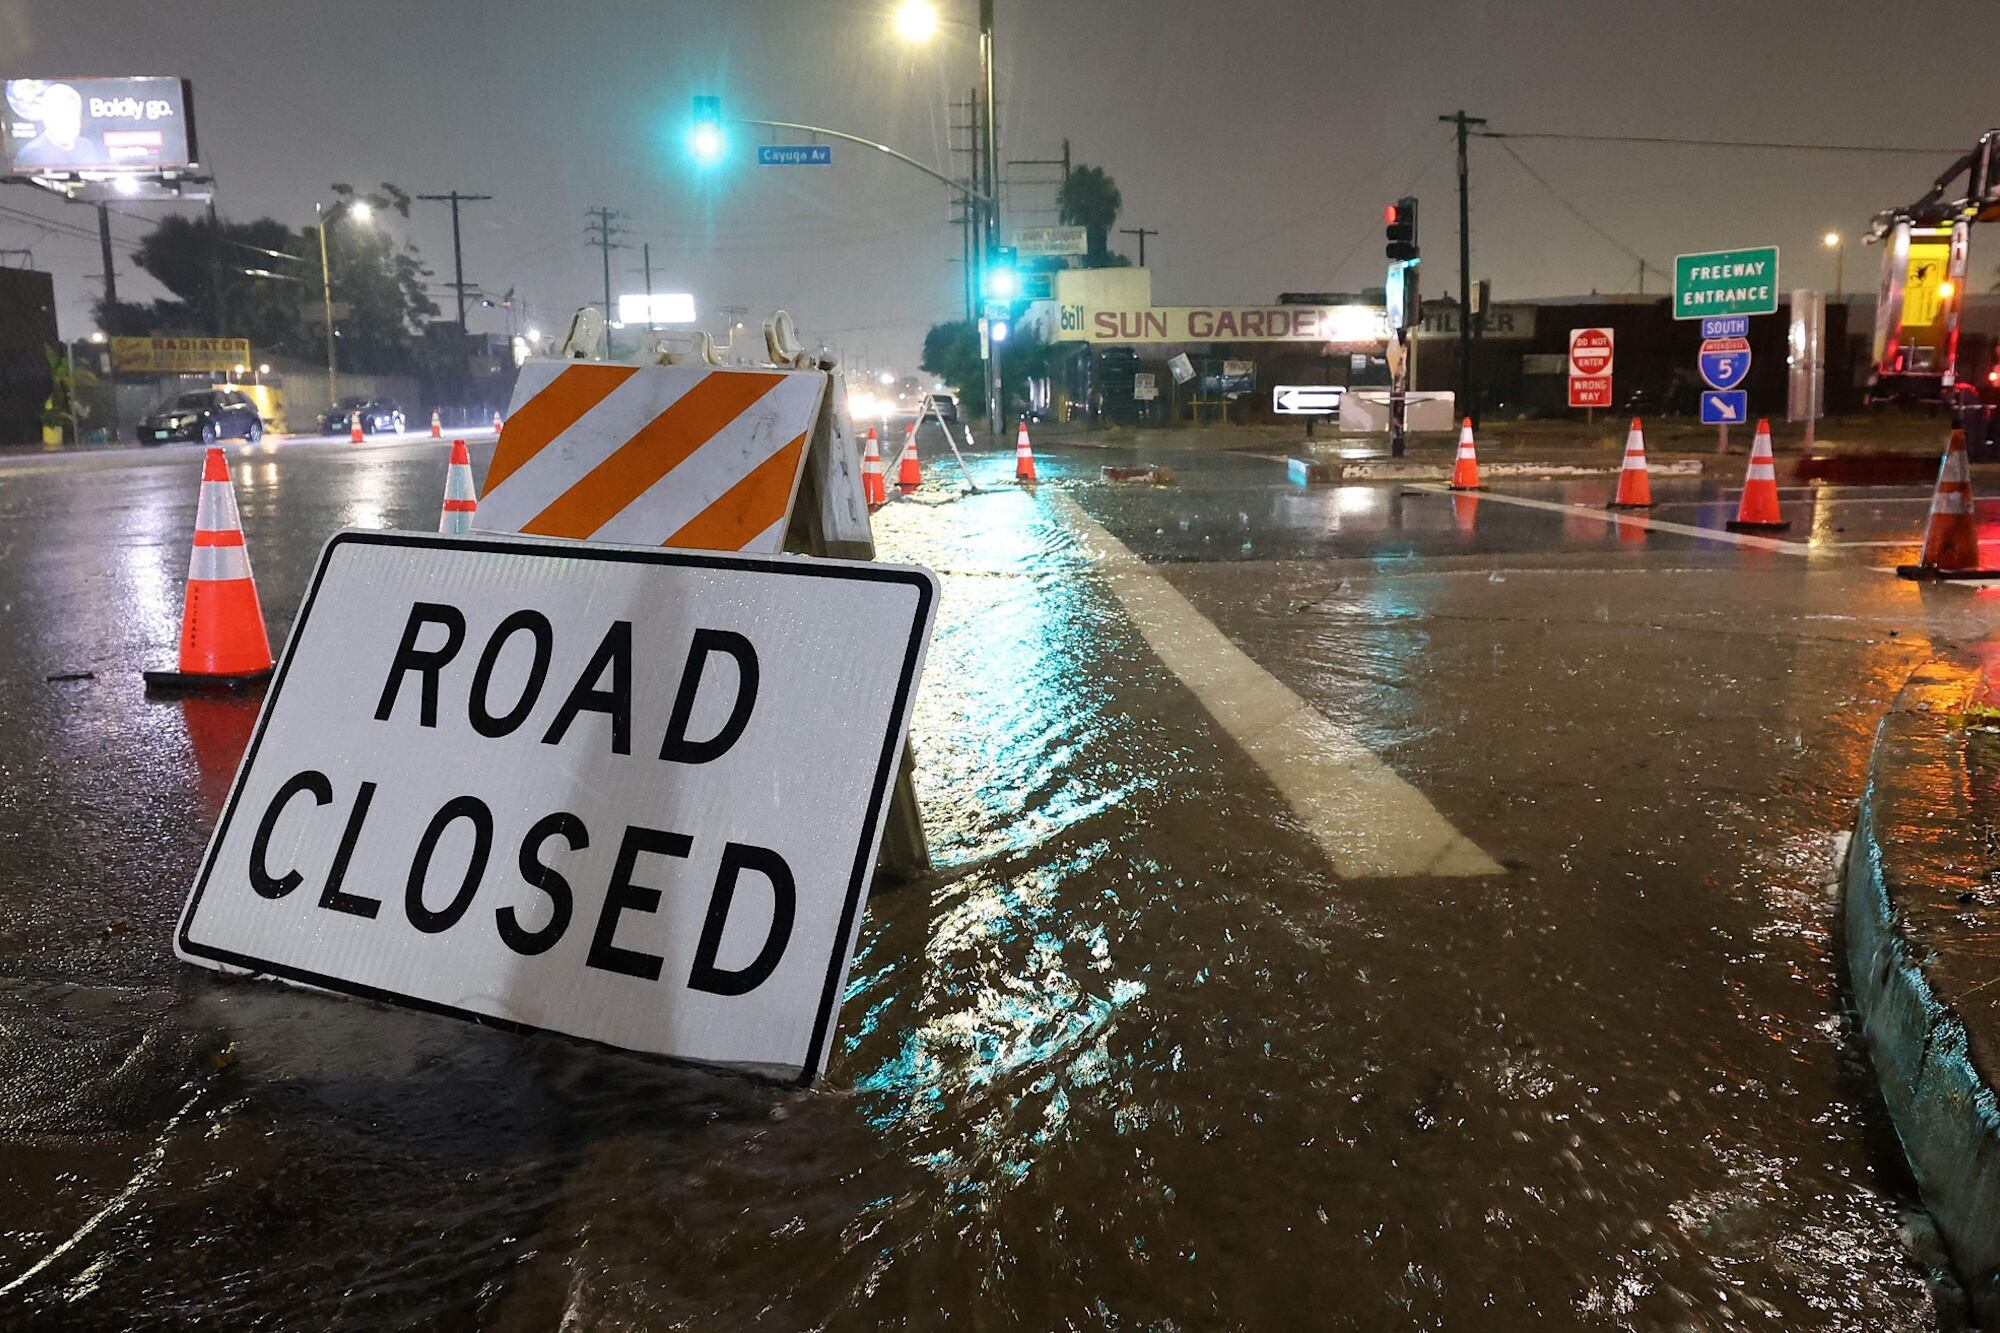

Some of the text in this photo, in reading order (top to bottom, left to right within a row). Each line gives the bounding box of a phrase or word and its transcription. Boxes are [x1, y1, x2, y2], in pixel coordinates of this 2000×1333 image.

[89, 98, 173, 121] Boldly go.
[764, 150, 825, 162] Cayuga Av
[1691, 262, 1765, 281] FREEWAY
[1683, 286, 1769, 305] ENTRANCE
[1094, 311, 1167, 338] SUN
[1707, 320, 1745, 335] SOUTH
[151, 339, 247, 350] RADIATOR
[1576, 338, 1606, 346] DO NOT
[1578, 357, 1604, 367] ENTER
[1719, 359, 1732, 379] 5
[1574, 380, 1607, 390] WRONG
[1580, 391, 1600, 401] WAY
[374, 601, 760, 765] ROAD
[248, 770, 796, 997] CLOSED
